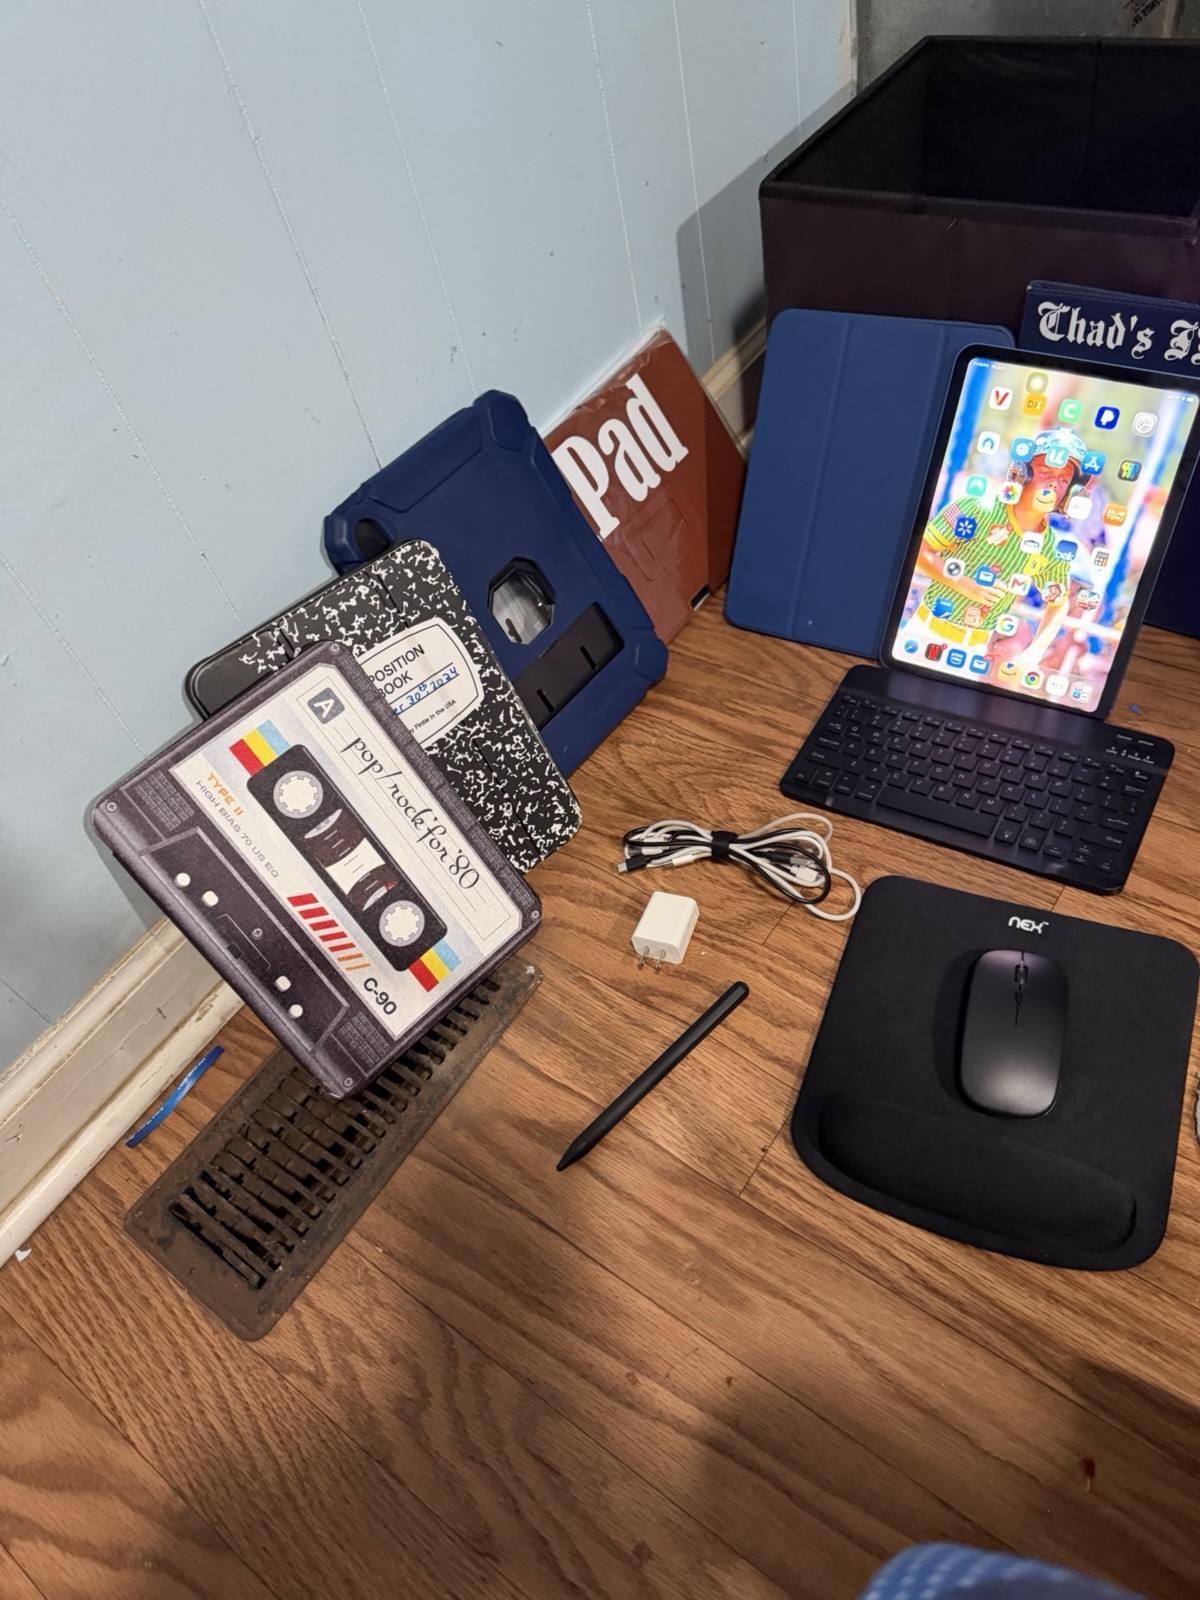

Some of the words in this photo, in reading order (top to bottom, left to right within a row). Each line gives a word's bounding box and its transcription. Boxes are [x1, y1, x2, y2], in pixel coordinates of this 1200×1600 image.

[551, 373, 688, 541] Pad
[313, 698, 335, 719] A
[207, 772, 235, 806] TYPE
[195, 780, 220, 808] HIGH
[218, 807, 241, 834] BIAS
[241, 833, 252, 847] 70
[251, 846, 266, 862] US
[363, 977, 397, 1015] C-90
